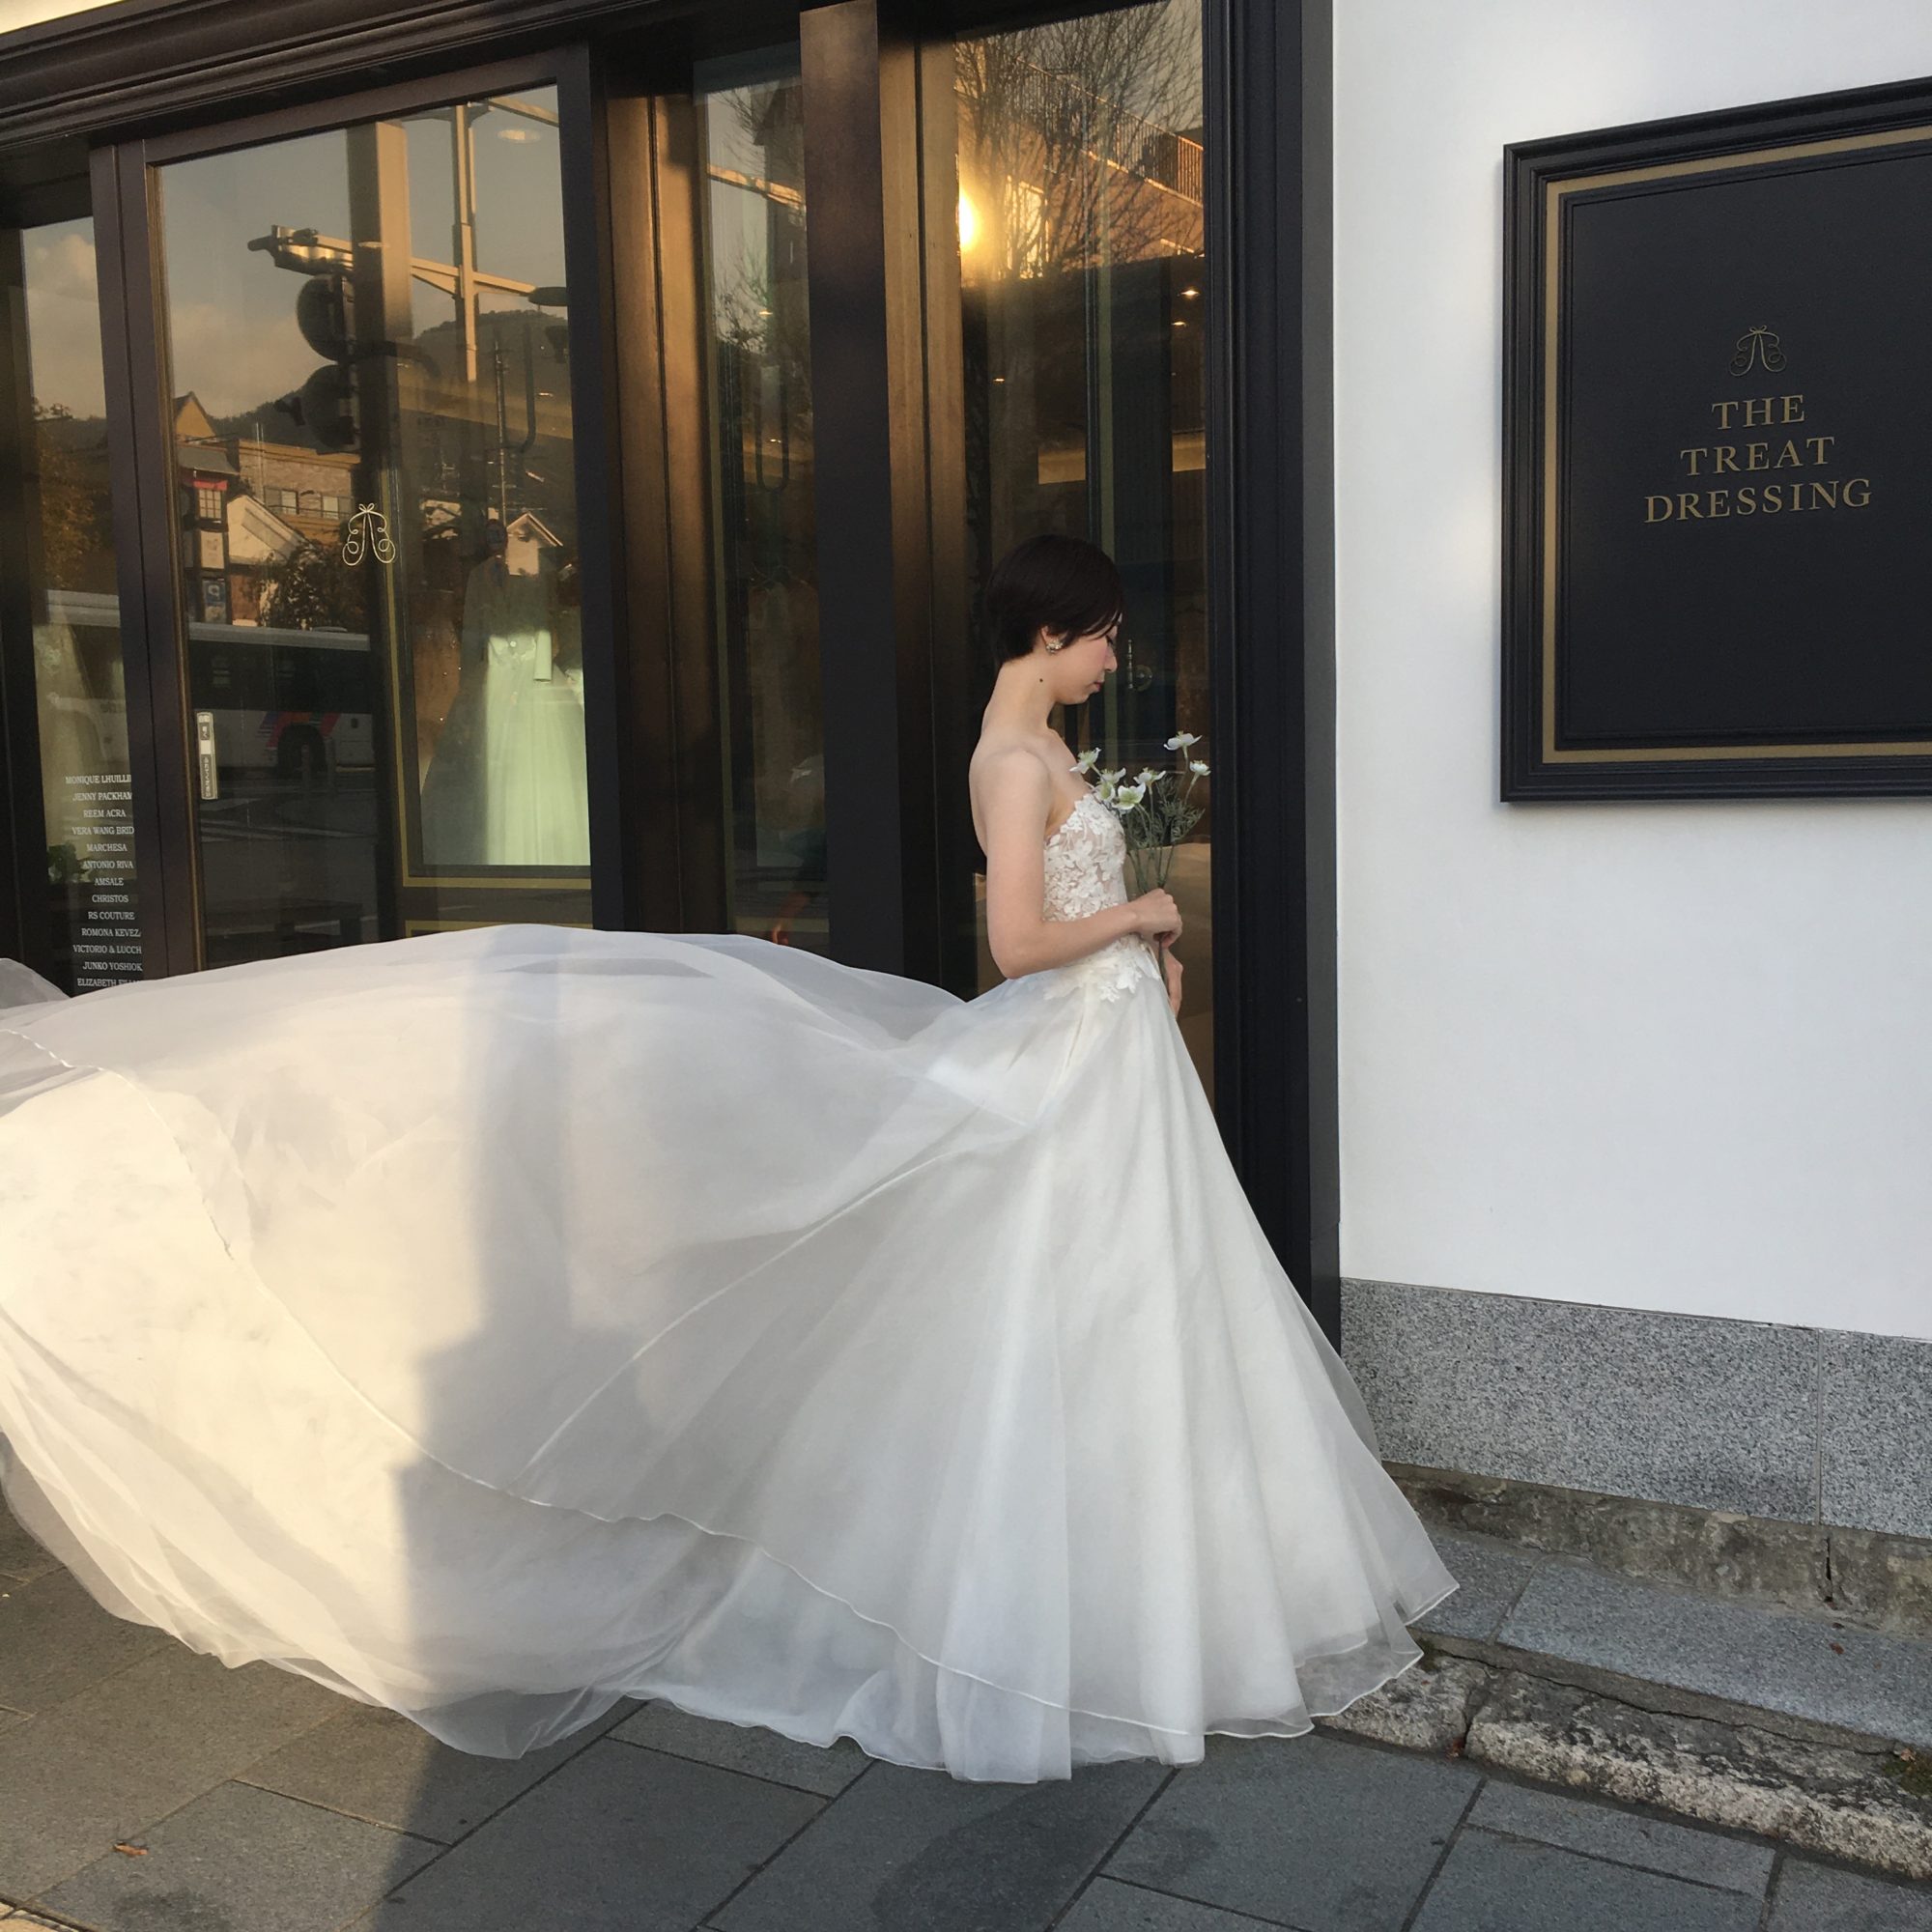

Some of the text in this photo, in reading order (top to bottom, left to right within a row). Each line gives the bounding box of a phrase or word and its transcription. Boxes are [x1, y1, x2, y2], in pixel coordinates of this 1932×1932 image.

[1711, 394, 1804, 430] THE
[1680, 436, 1835, 476] TREAT
[1644, 478, 1872, 524] DRESSING
[66, 776, 100, 784] MONIQUE
[73, 792, 97, 801] JENNY
[83, 810, 104, 818] REEM
[72, 827, 92, 836] VERA
[72, 945, 107, 953] VICTORIO
[77, 979, 116, 987] ELIZABETH
